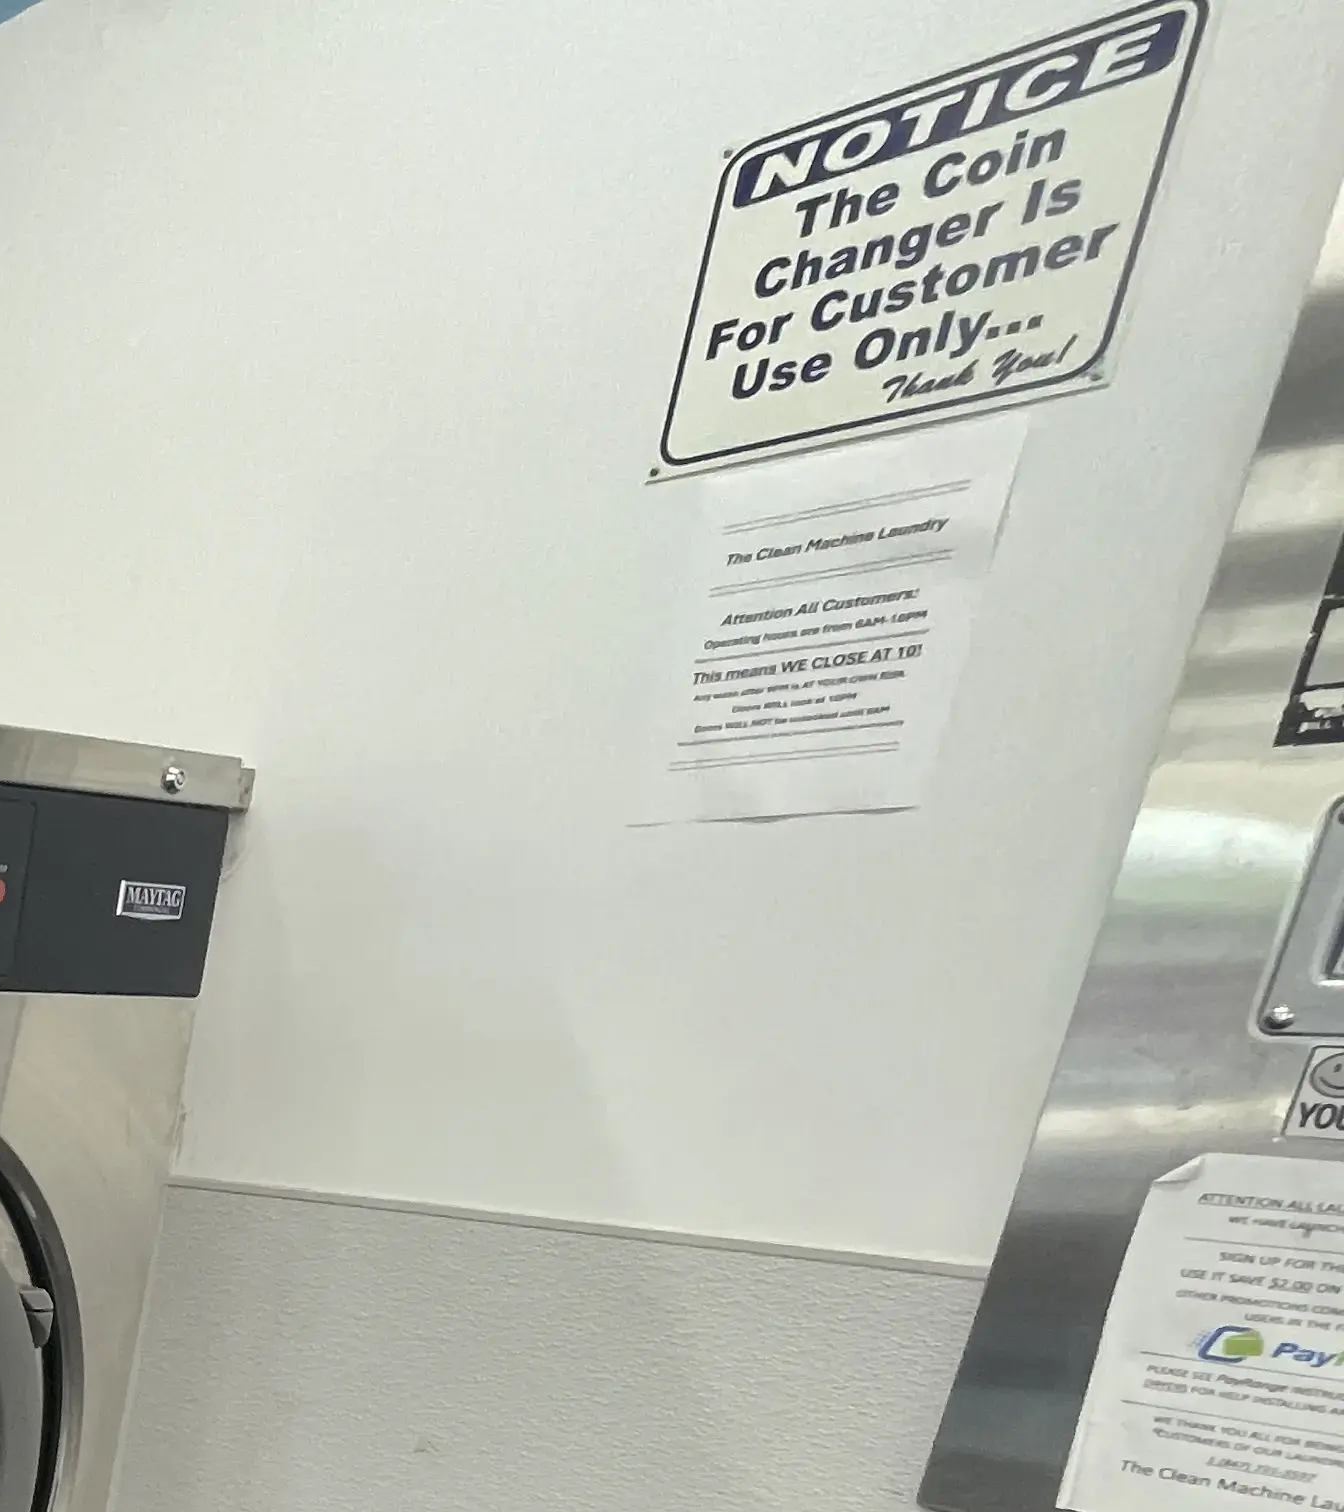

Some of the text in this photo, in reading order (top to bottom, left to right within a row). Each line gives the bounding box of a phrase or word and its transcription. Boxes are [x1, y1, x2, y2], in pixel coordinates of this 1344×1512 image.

[744, 22, 1162, 200] NOTICE
[796, 127, 1067, 238] The Coin
[755, 177, 1082, 298] Changer Is
[705, 223, 1119, 360] For Customer
[731, 310, 1042, 400] Use Only...
[882, 334, 1078, 403] Thank You!
[725, 517, 950, 567] The Clean Machine Laundry
[720, 601, 820, 626] Attention All
[692, 644, 923, 685] This means WE CLOSE AT 10!
[126, 886, 181, 907] MAYTAG
[1284, 1258, 1315, 1269] FOR
[1121, 1459, 1154, 1477] The
[1158, 1467, 1211, 1487] Clean
[1217, 1478, 1305, 1505] Machine
